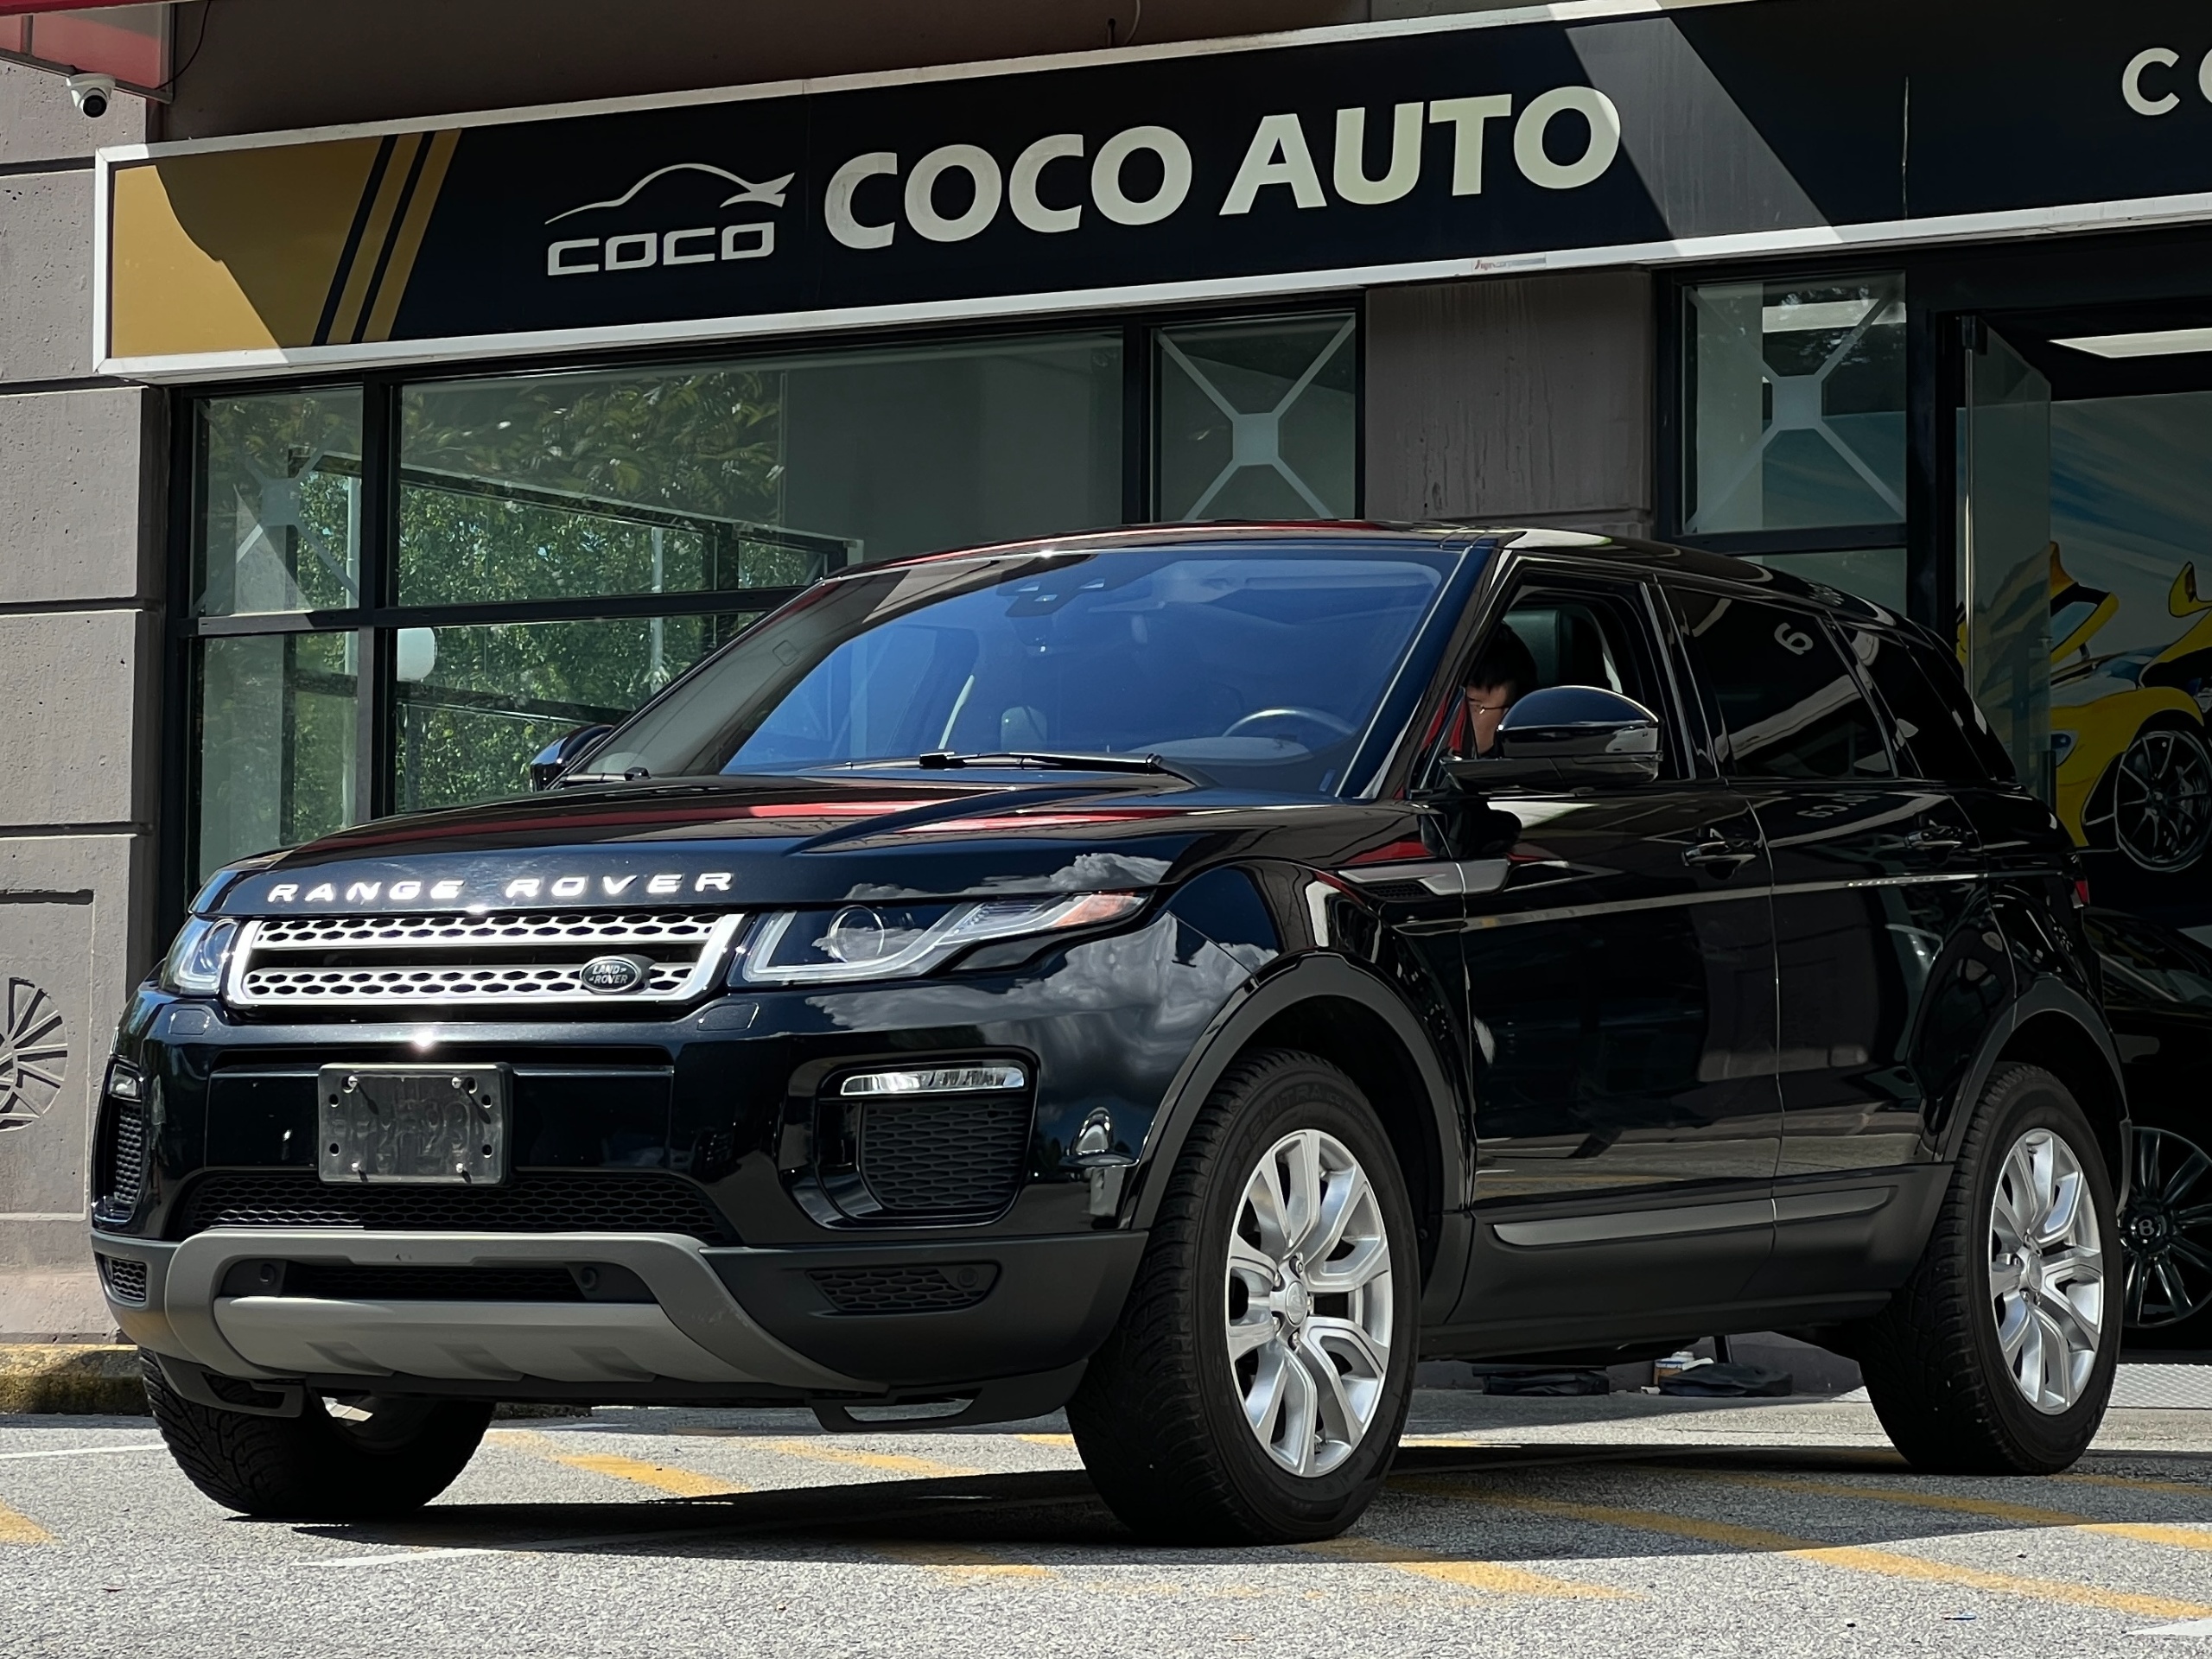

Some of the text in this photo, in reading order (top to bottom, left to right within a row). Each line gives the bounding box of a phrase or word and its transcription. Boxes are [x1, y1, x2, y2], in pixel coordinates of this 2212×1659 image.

[2122, 48, 2212, 116] C
[823, 86, 1621, 249] COCO AUTO
[546, 220, 776, 276] COCO
[267, 872, 734, 904] RANGE ROVER
[593, 964, 620, 975] LAND
[594, 974, 628, 984] ROVER
[2139, 1219, 2155, 1236] B
